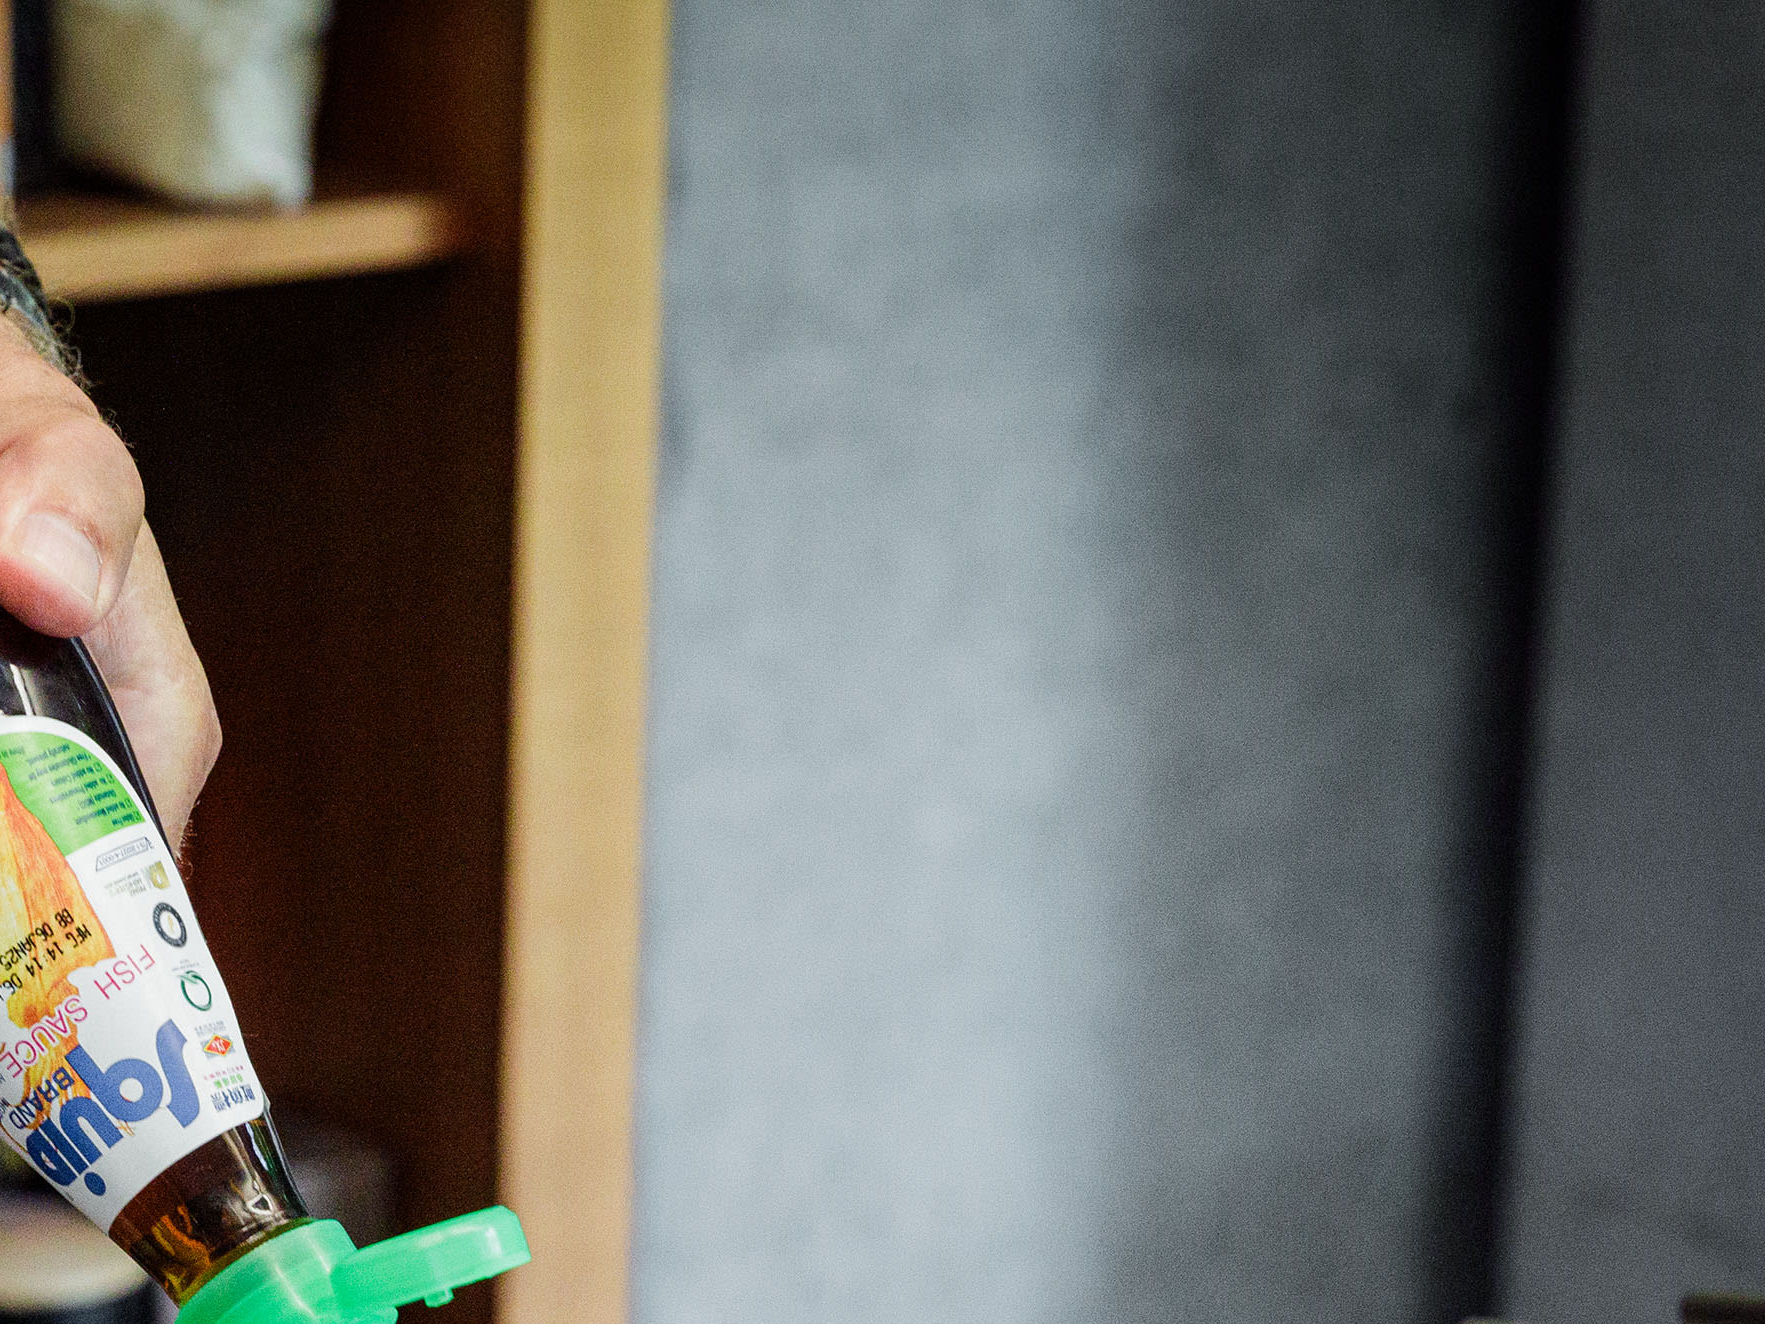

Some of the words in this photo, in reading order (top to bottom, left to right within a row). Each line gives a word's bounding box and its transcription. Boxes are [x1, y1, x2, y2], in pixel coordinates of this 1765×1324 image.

[53, 907, 74, 929] BB
[64, 923, 91, 948] MFG
[24, 941, 63, 976] 14:14
[92, 944, 155, 999] FISH
[7, 1066, 74, 1129] BRAND
